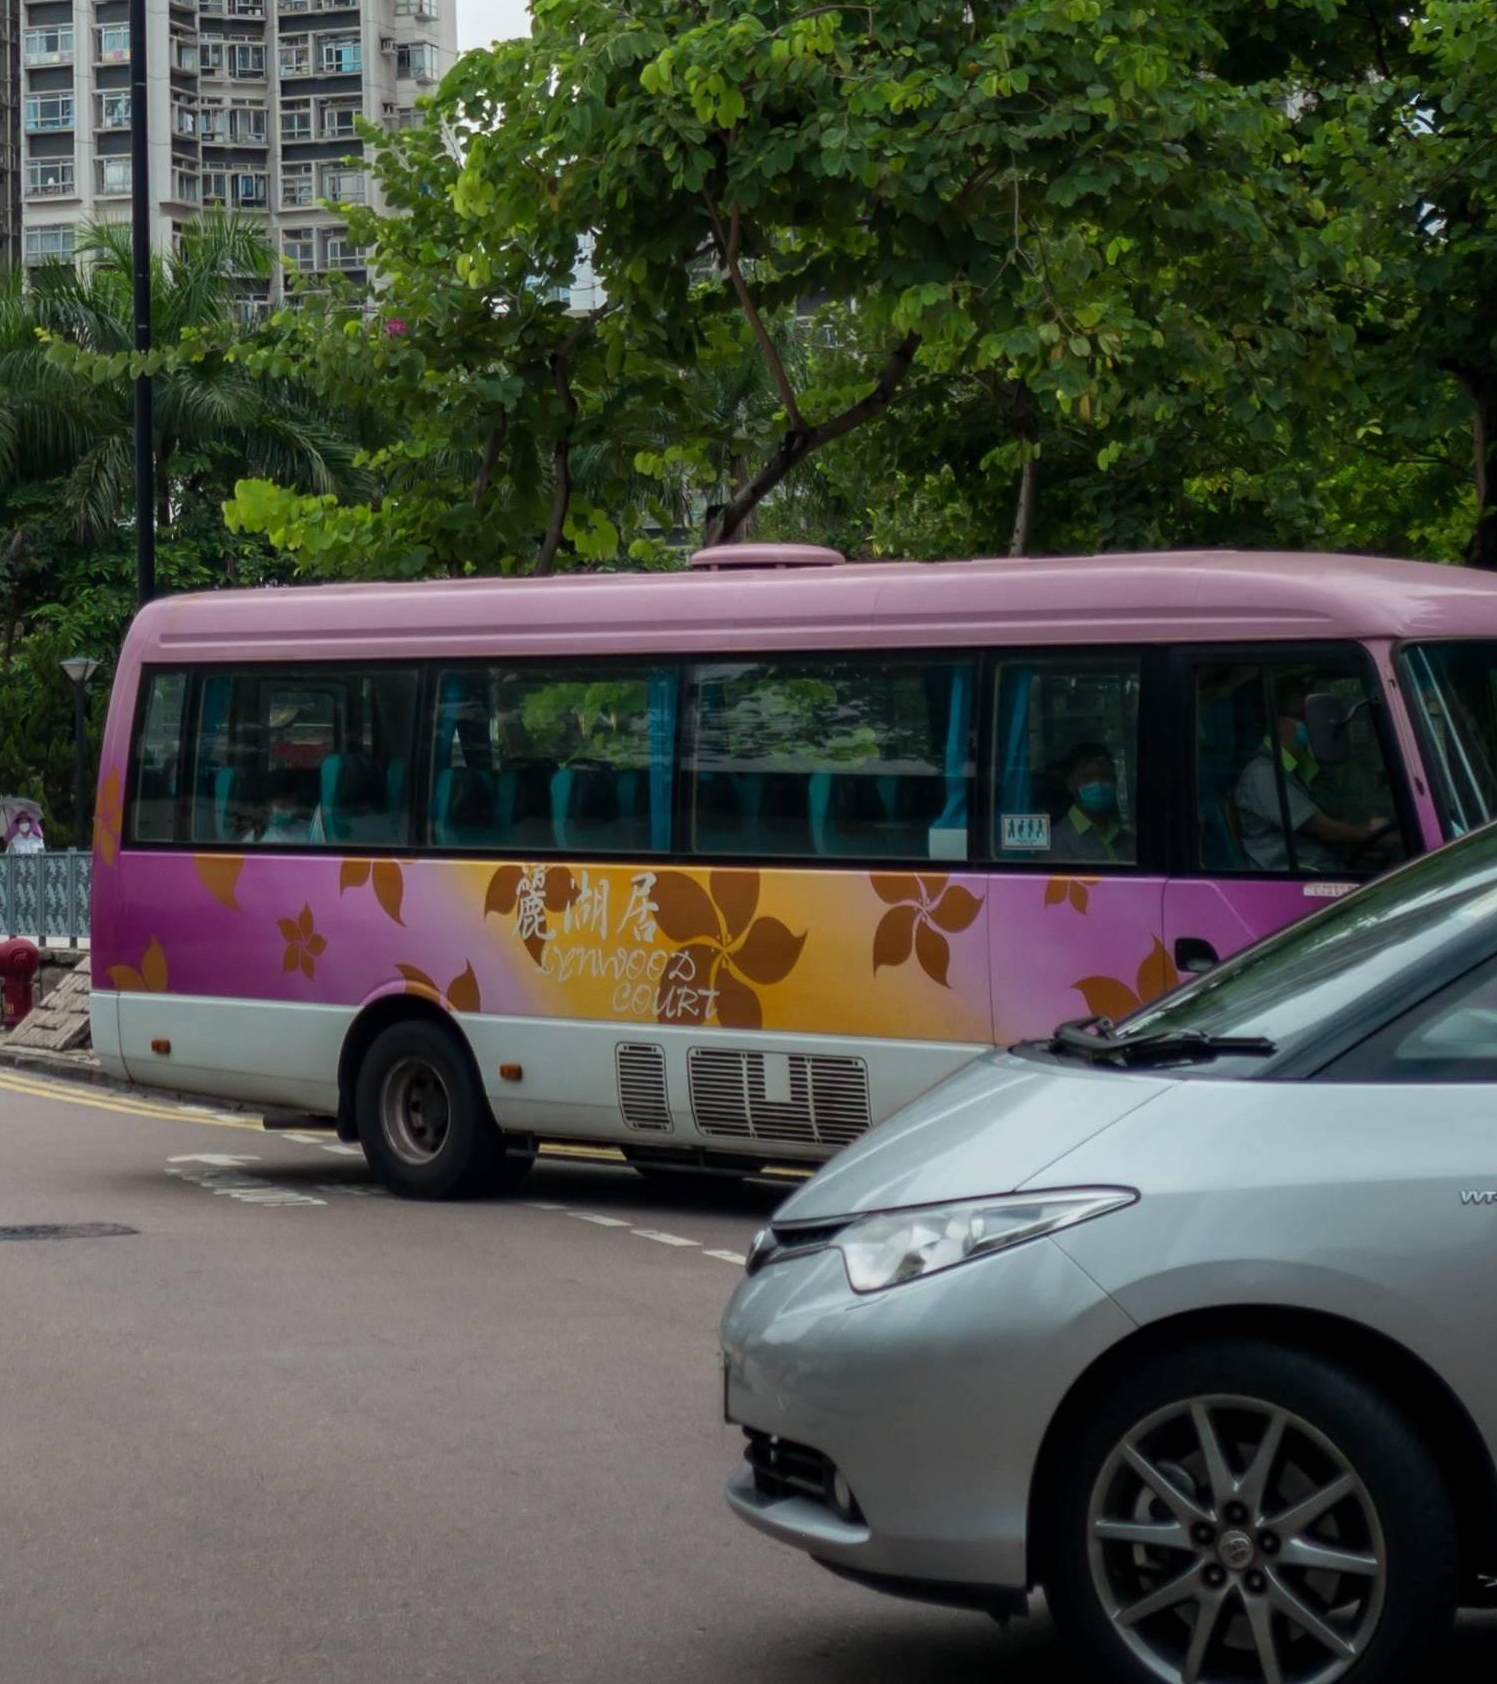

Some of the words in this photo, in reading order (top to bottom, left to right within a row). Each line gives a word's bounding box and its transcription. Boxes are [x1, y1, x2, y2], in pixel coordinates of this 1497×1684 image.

[512, 864, 659, 943] 麗湖居
[611, 982, 720, 1019] COURT
